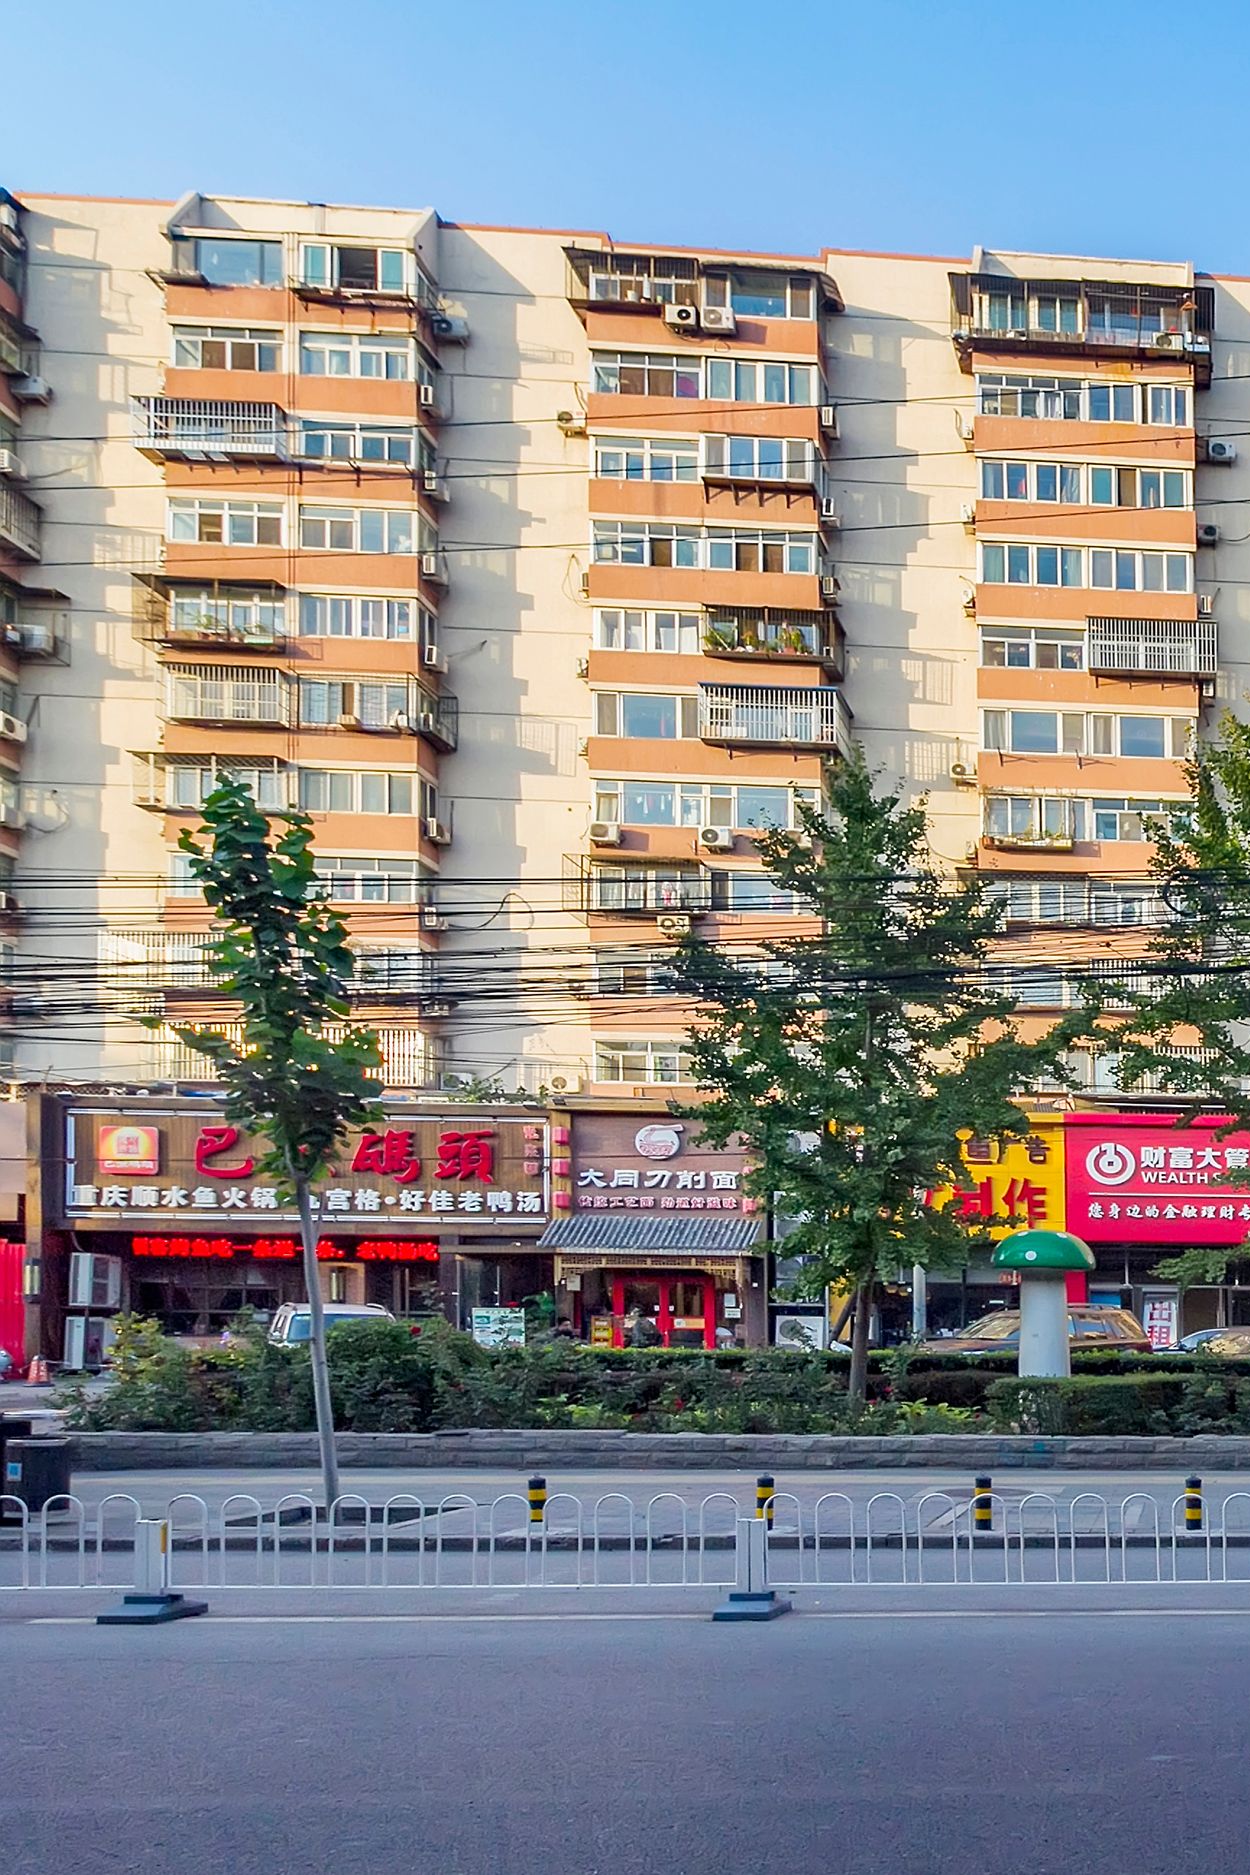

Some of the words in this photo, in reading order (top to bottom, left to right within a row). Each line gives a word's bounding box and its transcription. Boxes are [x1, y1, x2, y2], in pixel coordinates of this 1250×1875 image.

[195, 1126, 495, 1184] 巴碼頭
[577, 1168, 740, 1190] 大同刀削面
[1141, 1171, 1208, 1184] WEALTH
[1148, 1301, 1172, 1345] 出租
